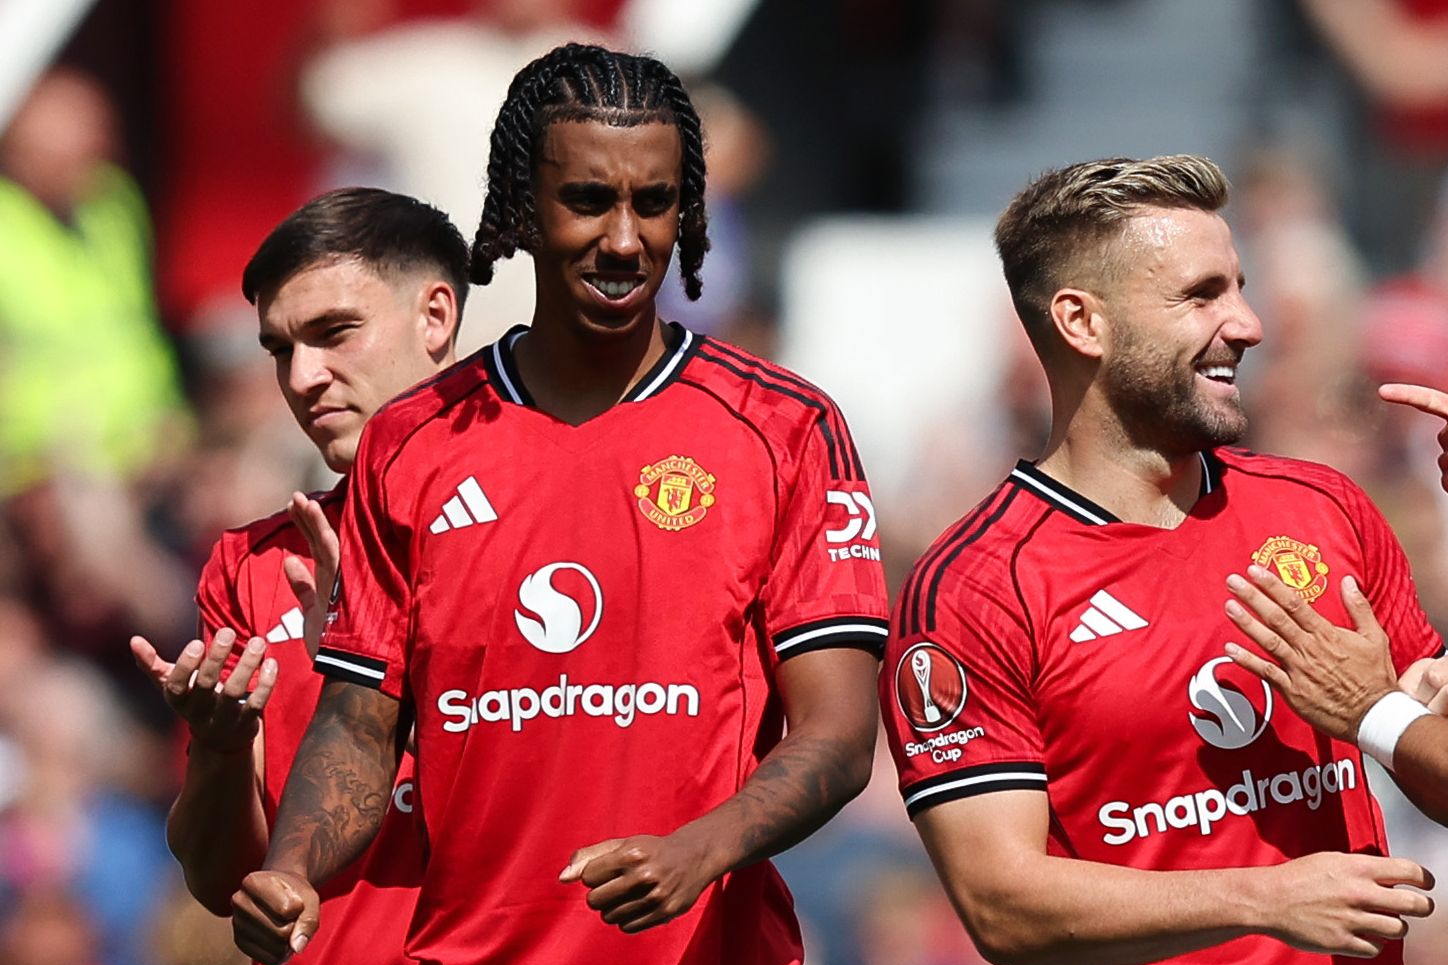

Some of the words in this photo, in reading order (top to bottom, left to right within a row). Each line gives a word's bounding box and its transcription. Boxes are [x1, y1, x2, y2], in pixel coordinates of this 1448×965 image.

[646, 460, 709, 489] MANCHESTER
[649, 508, 695, 527] UNITED
[827, 543, 881, 563] TECHN
[1258, 540, 1316, 565] MANCHESTER
[905, 726, 985, 758] Snapdragon
[932, 747, 963, 763] Cup
[1098, 758, 1355, 845] Snapdragon
